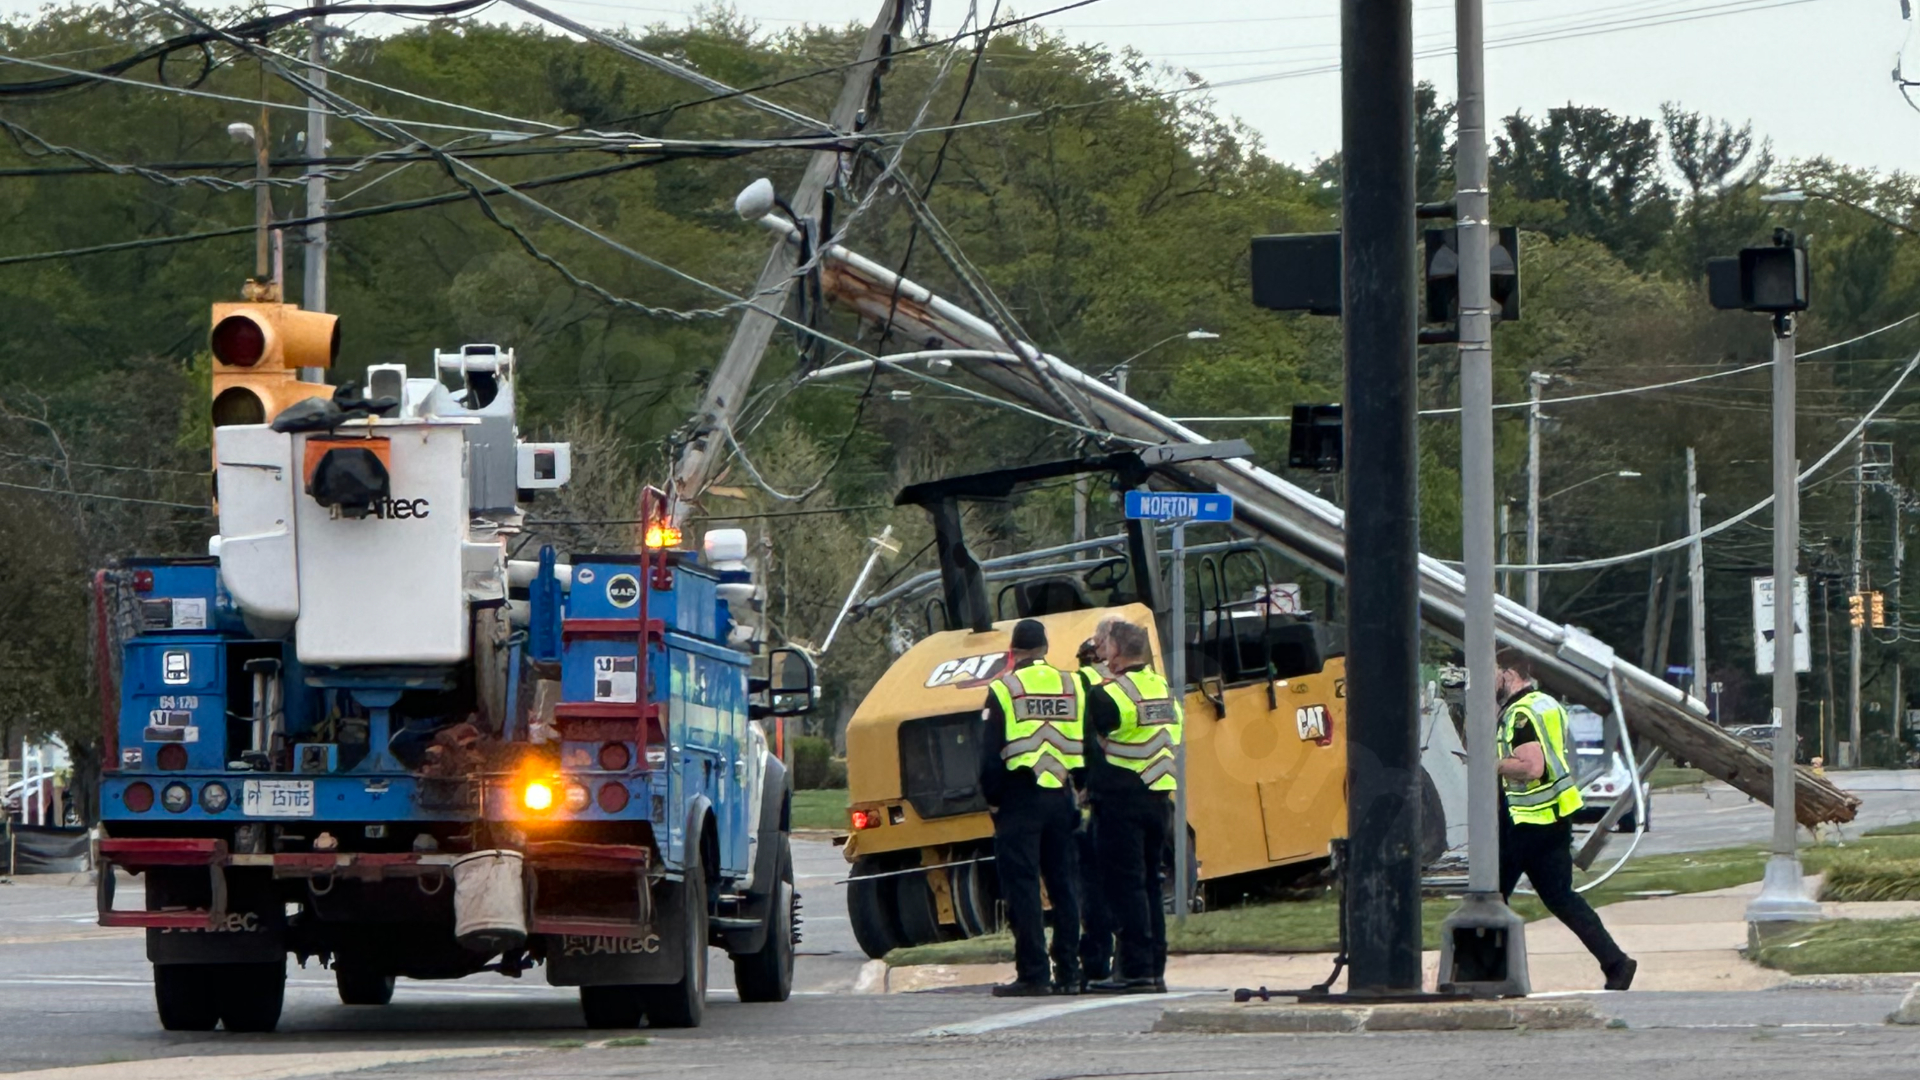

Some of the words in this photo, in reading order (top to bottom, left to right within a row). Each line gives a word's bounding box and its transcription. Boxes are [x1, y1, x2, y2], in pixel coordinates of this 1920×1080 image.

[1140, 496, 1199, 517] NORTON
[925, 652, 1006, 688] CAT
[1026, 699, 1069, 716] FIRE
[1296, 706, 1326, 740] CAT
